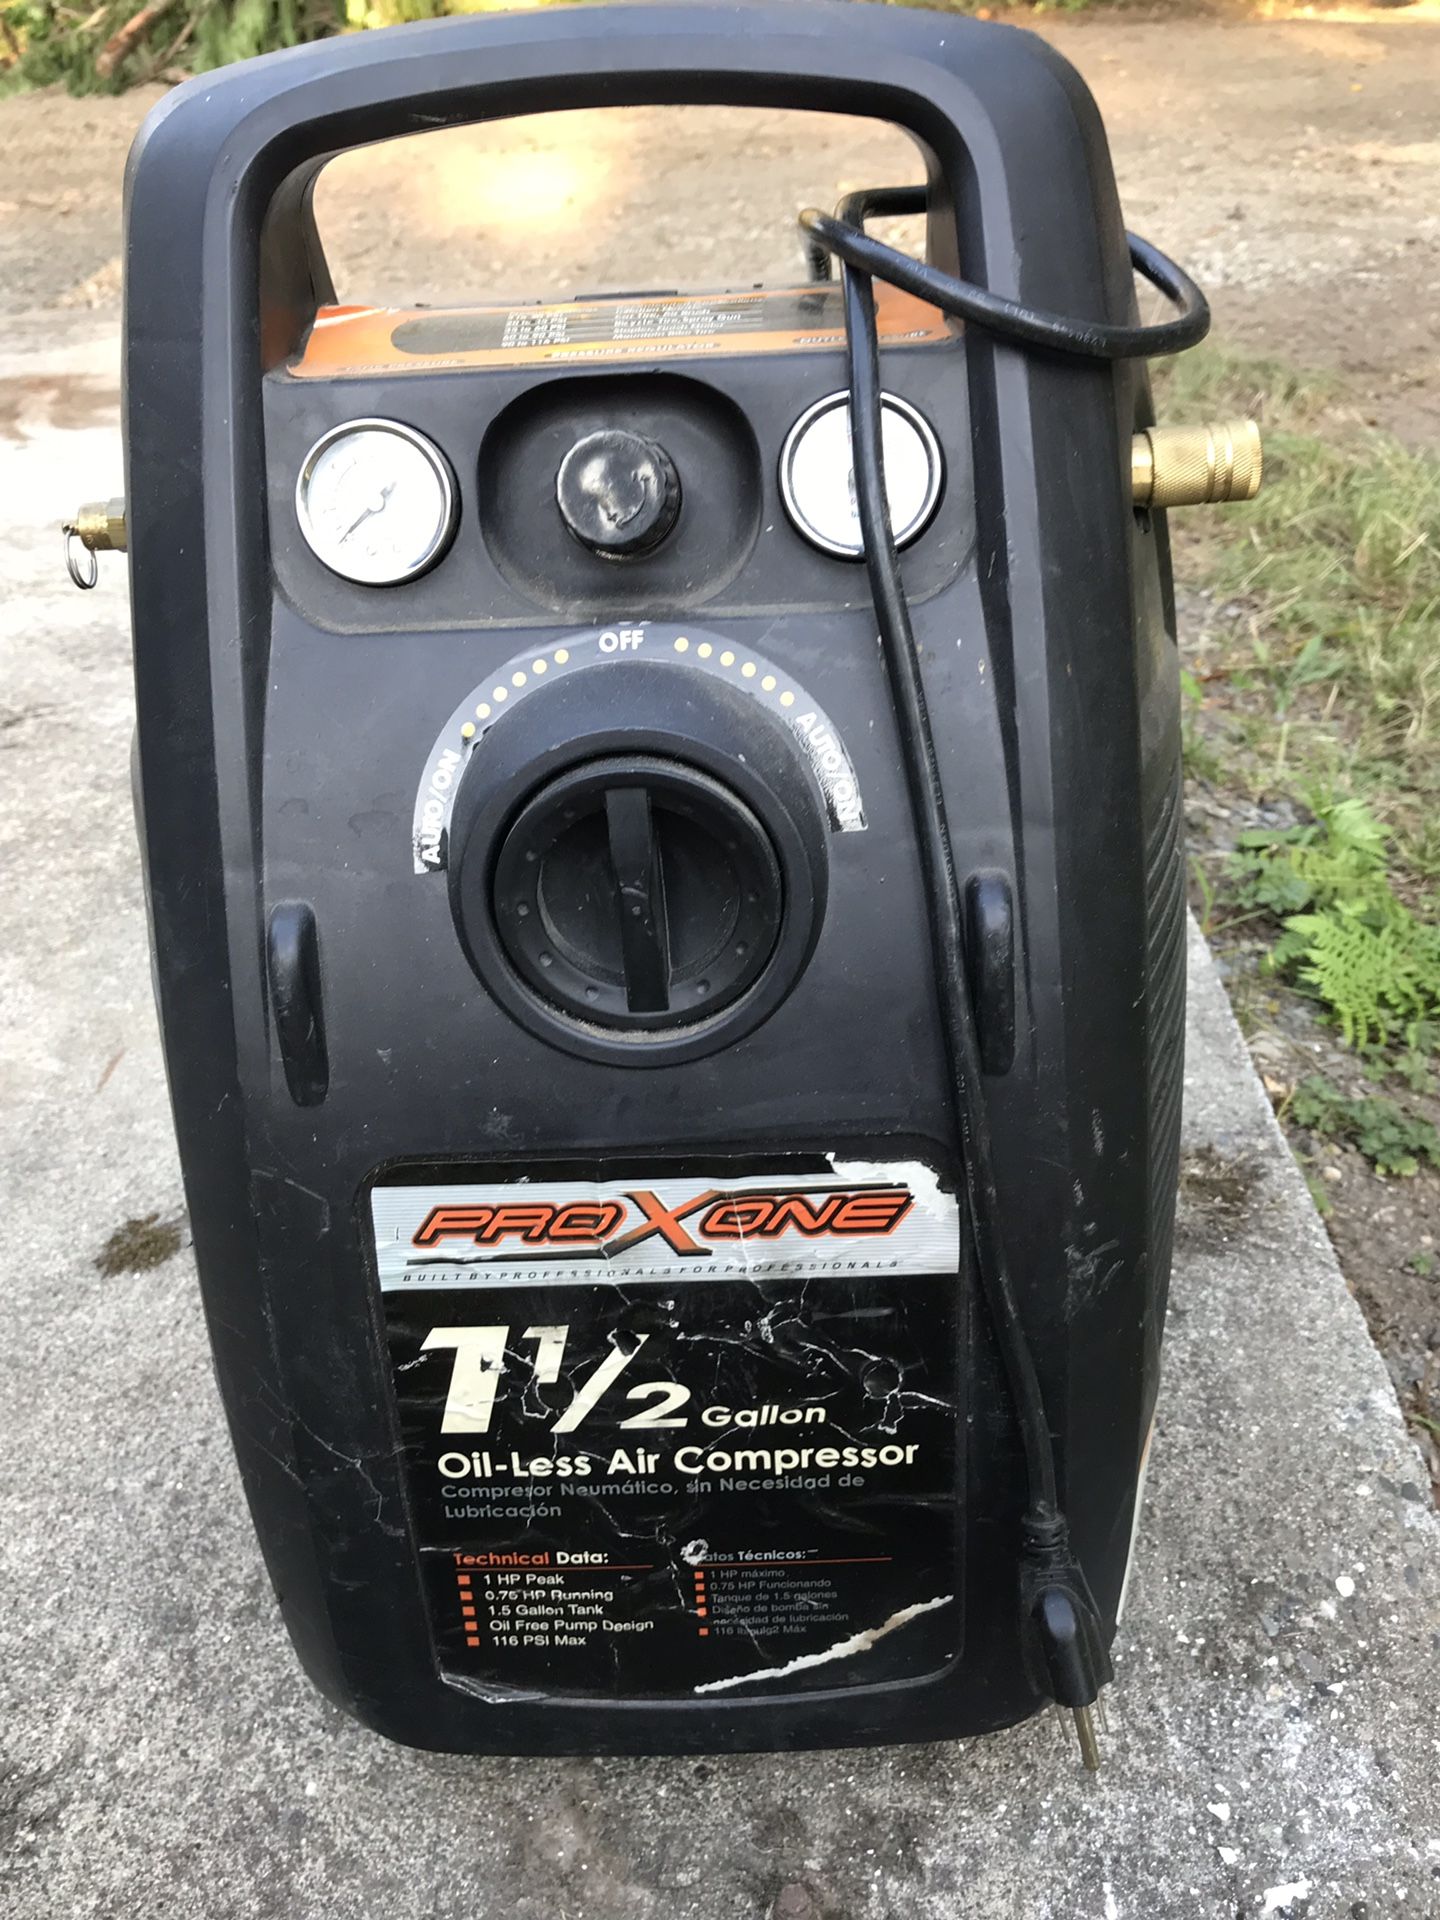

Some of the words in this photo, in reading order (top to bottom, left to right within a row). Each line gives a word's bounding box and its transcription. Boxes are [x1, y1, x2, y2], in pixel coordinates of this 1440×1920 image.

[598, 629, 645, 653] OFF
[796, 712, 859, 821] AUTO/ON
[421, 748, 462, 864] AUTO/ON
[402, 1272, 461, 1282] BUILT
[469, 1272, 492, 1281] BY
[679, 1265, 716, 1274] FOR
[723, 1260, 898, 1274] PROFESSIONALS
[700, 1403, 827, 1428] Gallon
[437, 1451, 592, 1479] Oil-Less
[606, 1449, 660, 1475] Air
[673, 1442, 920, 1478] Compressor
[441, 1482, 553, 1502] Compresor
[561, 1479, 679, 1499] Neumático,
[719, 1474, 830, 1491] Necesidad
[838, 1474, 865, 1488] de
[445, 1504, 562, 1520] Lubricación
[453, 1552, 549, 1566] Technical
[556, 1551, 609, 1565] Data:
[694, 1551, 735, 1563] atos
[483, 1574, 491, 1585] 1
[498, 1574, 521, 1585] HP
[526, 1573, 565, 1585] Peak
[720, 1570, 738, 1578] HP
[741, 1569, 786, 1578] máximo
[710, 1582, 735, 1591] 0.75
[739, 1581, 756, 1590] HP
[759, 1580, 832, 1589] Funcionando
[485, 1590, 518, 1601] 0.75
[523, 1590, 546, 1601] HP
[551, 1588, 614, 1602] Running
[711, 1593, 752, 1603] Tanque
[774, 1592, 790, 1600] 1.5
[794, 1591, 838, 1601] galones
[488, 1605, 511, 1616] 1.5
[516, 1605, 564, 1616] Gallon
[568, 1604, 604, 1615] Tank
[772, 1614, 786, 1623] de
[789, 1613, 849, 1623] lubricación
[489, 1620, 511, 1631] Oil
[516, 1620, 549, 1631] Free
[554, 1620, 598, 1632] Pump
[603, 1619, 654, 1632] Design
[714, 1627, 734, 1635] 116
[783, 1625, 807, 1634] Máx
[493, 1635, 519, 1647] 116
[523, 1635, 549, 1646] PSI
[555, 1635, 586, 1646] Max
